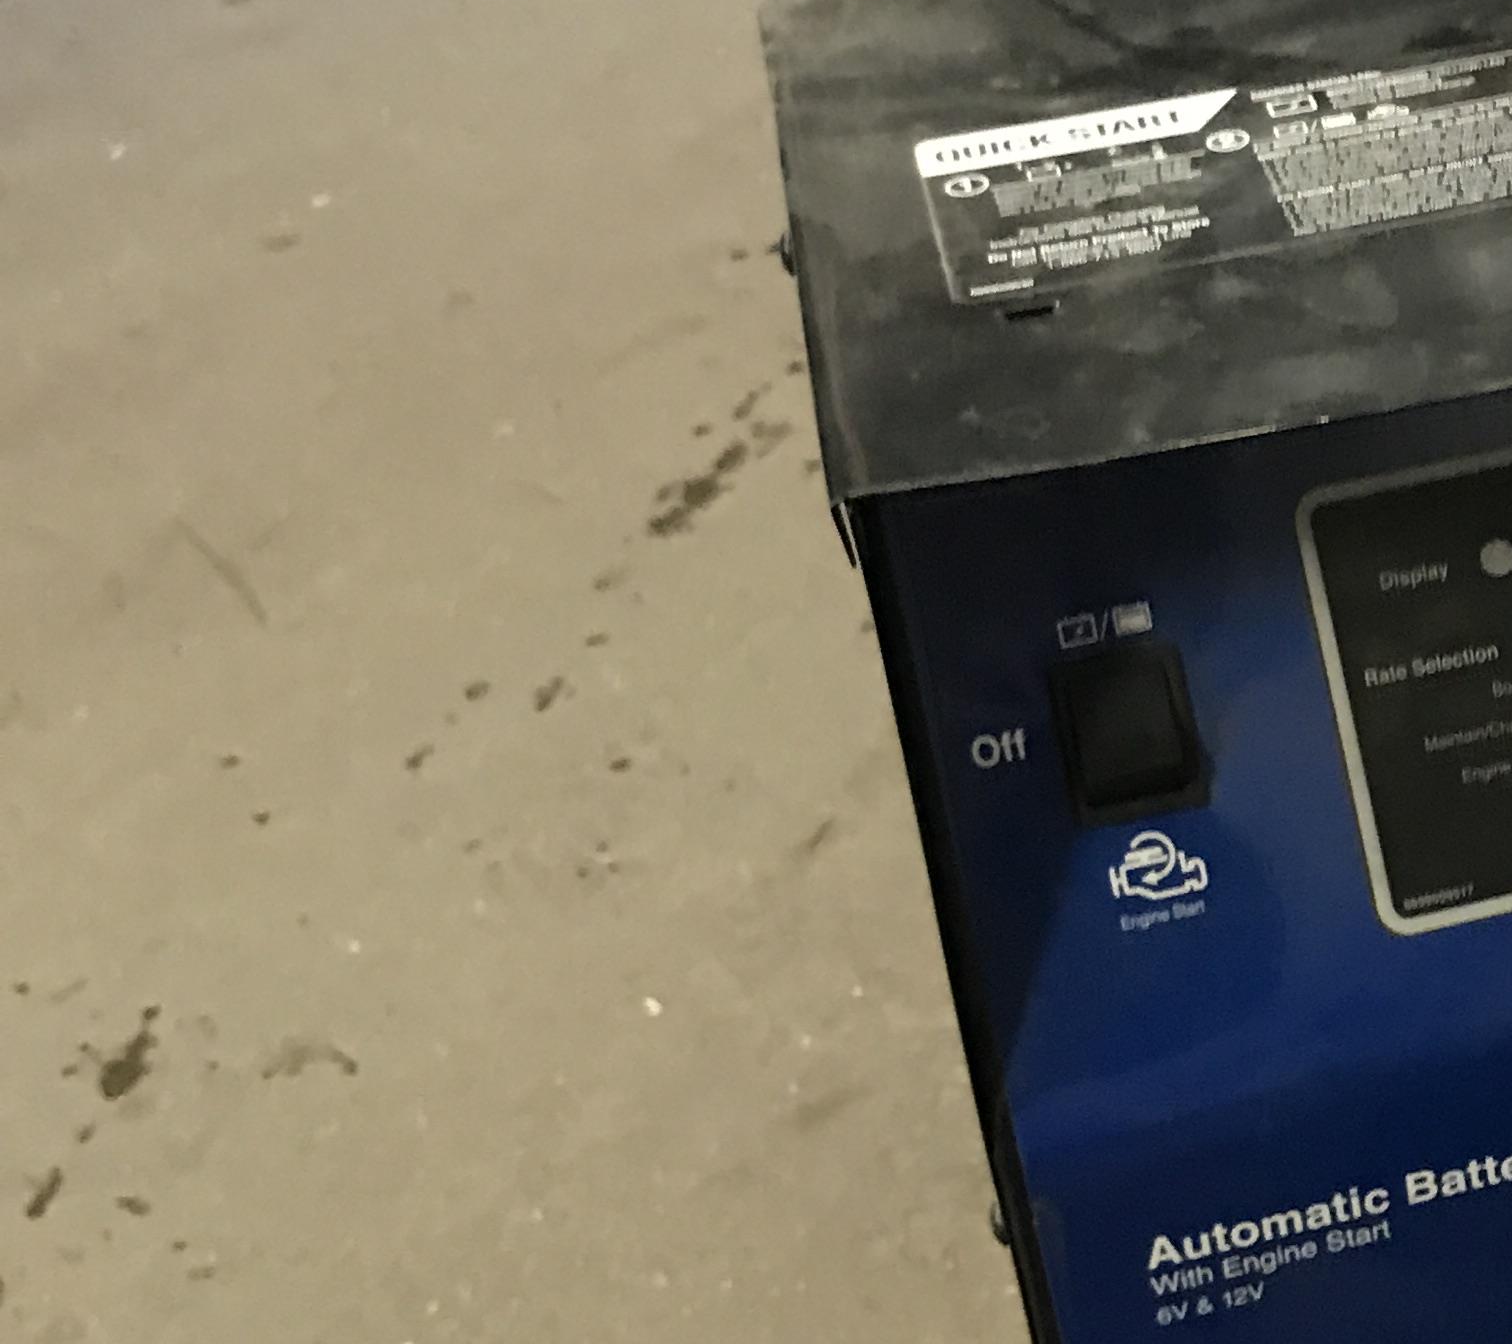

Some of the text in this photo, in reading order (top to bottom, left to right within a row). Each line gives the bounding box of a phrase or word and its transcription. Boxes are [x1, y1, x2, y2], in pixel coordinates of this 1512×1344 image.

[1379, 561, 1449, 592] Display
[1364, 643, 1500, 688] Rate Selection
[971, 727, 1026, 770] Off
[1147, 1185, 1391, 1271] Automatic
[1149, 1220, 1392, 1297] With Engine Start
[1155, 1281, 1266, 1327] 6V & 12V
